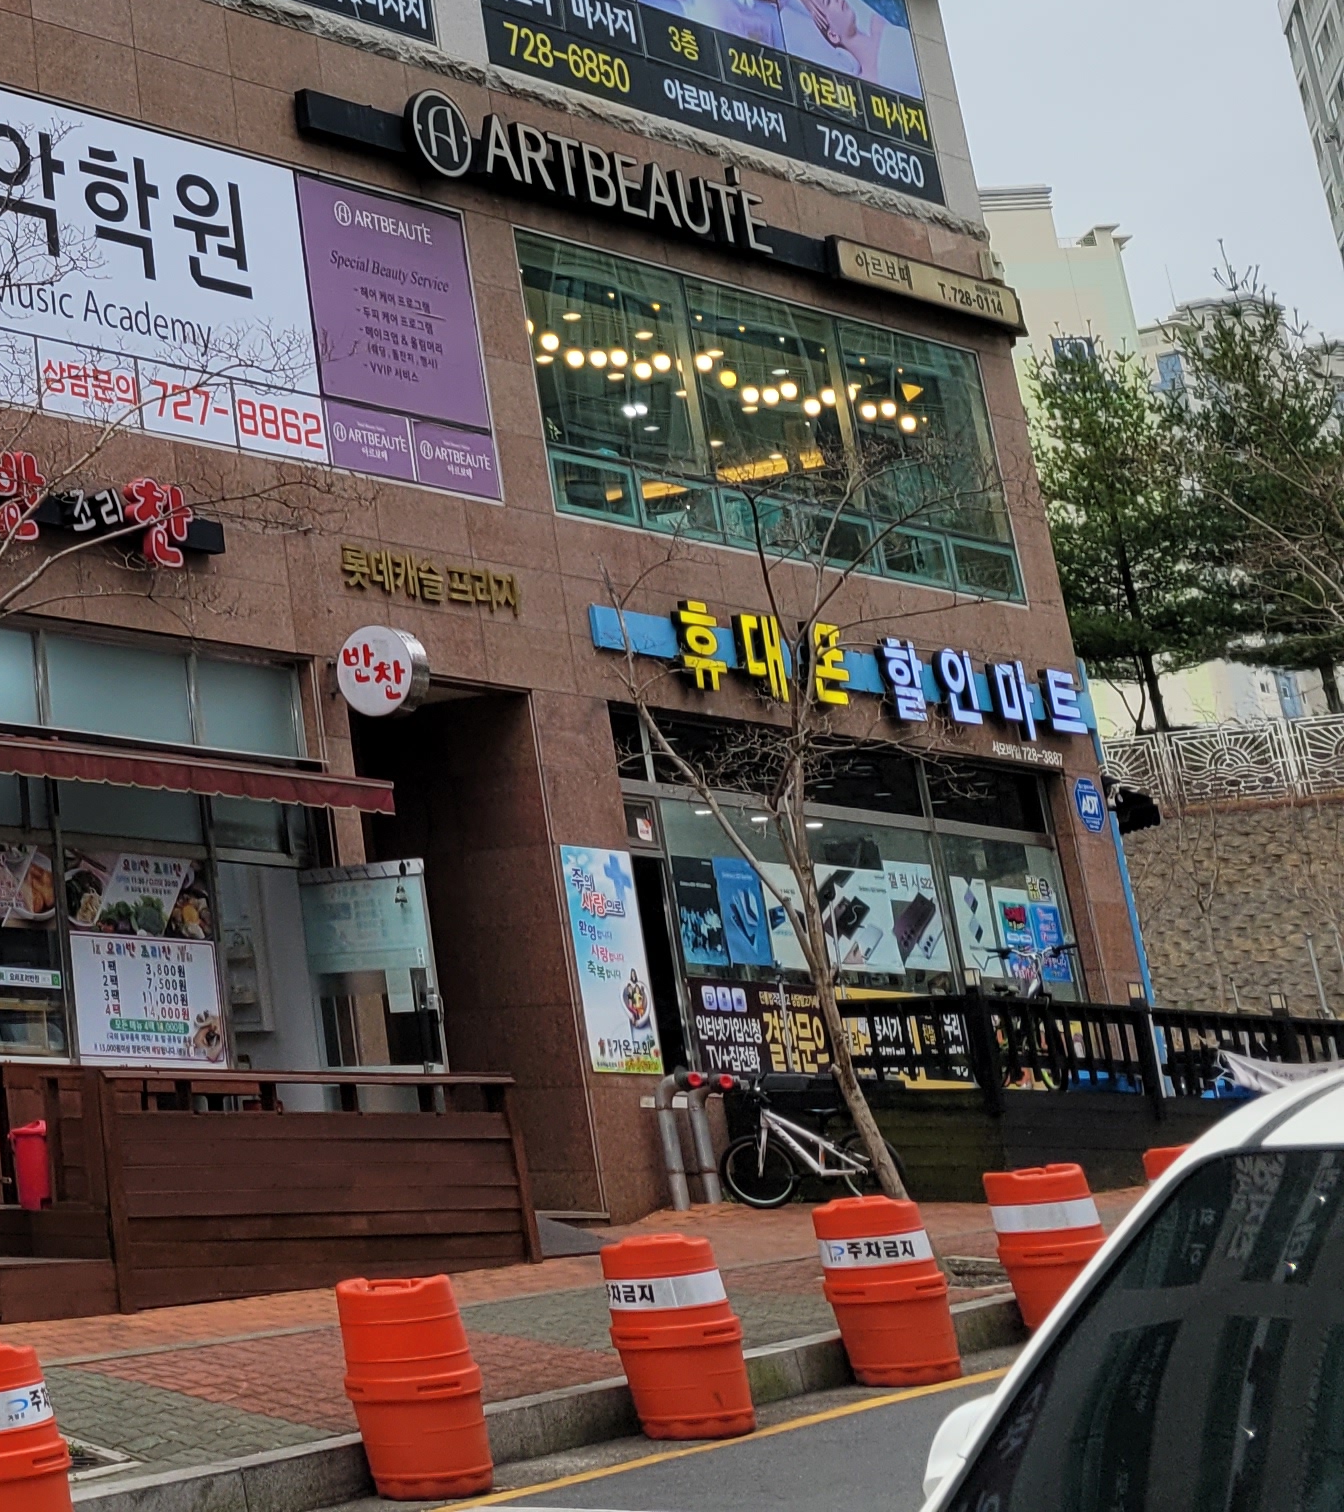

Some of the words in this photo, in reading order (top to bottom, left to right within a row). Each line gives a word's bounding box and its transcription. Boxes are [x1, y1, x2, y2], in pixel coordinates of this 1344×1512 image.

[503, 21, 631, 94] 728-6850
[668, 25, 701, 62] 3층
[727, 46, 784, 93] 24시간
[799, 69, 858, 118] 아로마
[871, 89, 928, 144] 마사지
[815, 124, 925, 190] 728-6850
[329, 250, 370, 273] Special
[371, 260, 409, 286] Beauty
[410, 271, 450, 293] Service
[82, 295, 214, 358] Academy
[41, 357, 139, 414] 상담문의
[341, 644, 406, 701] 반찬
[1022, 746, 1064, 767] 728-3887
[1082, 794, 1099, 815] ADT
[146, 963, 185, 978] 3,800원
[147, 978, 187, 993] 7,500원
[695, 1015, 762, 1044] 인터넷가입신청
[845, 1236, 916, 1261] 주차금지
